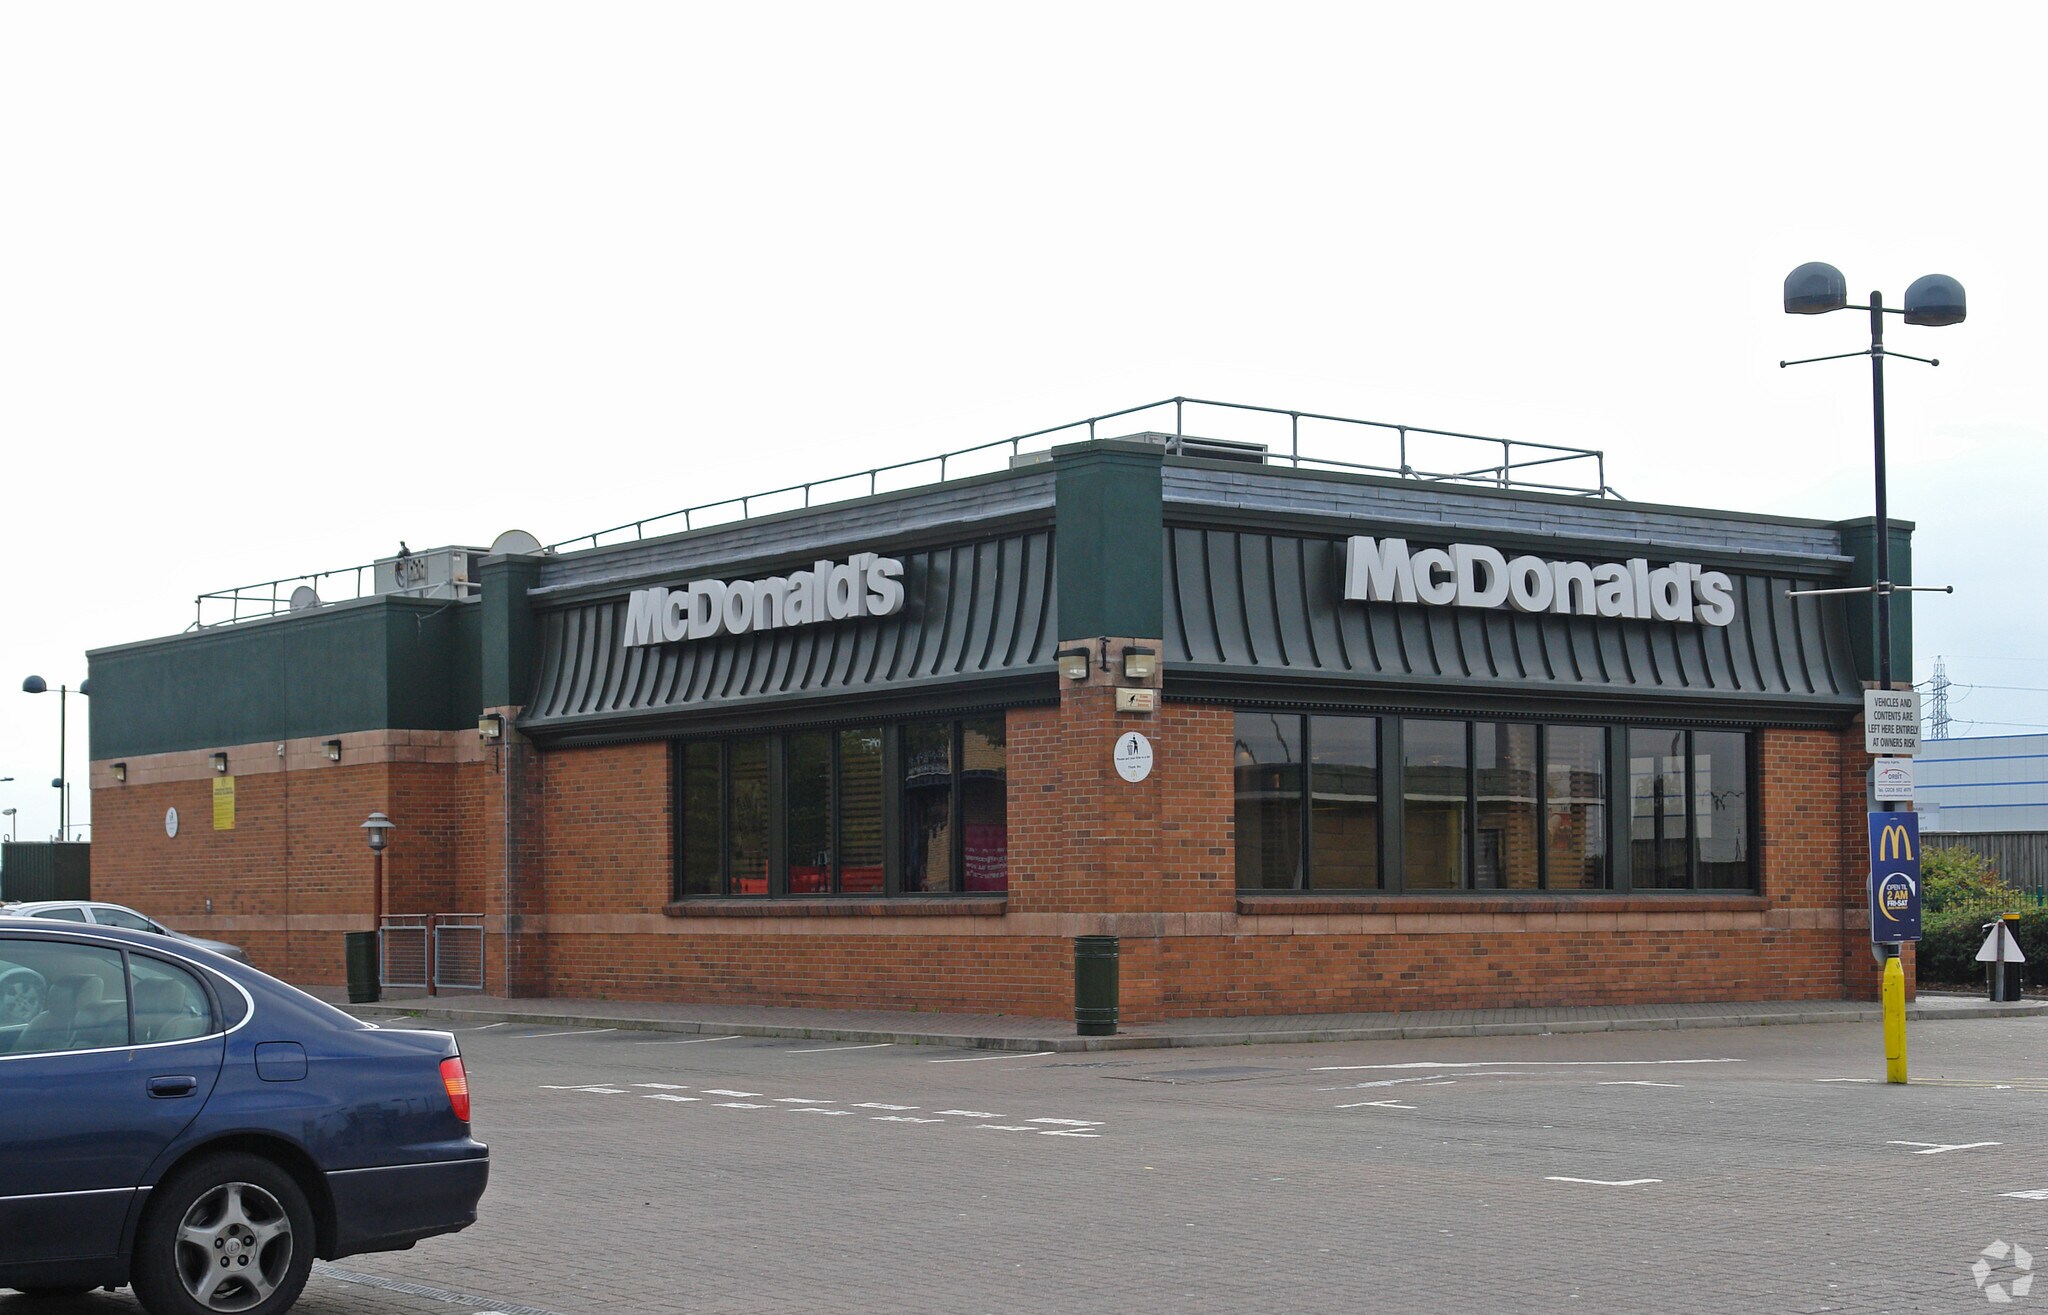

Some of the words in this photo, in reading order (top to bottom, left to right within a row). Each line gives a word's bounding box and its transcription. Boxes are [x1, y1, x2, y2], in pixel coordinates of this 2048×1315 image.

[1344, 535, 1735, 627] McDonald's
[624, 552, 904, 647] McDonald's
[1874, 698, 1898, 708] VEHICLES
[1900, 699, 1912, 708] AND
[1874, 711, 1900, 720] CONTENTS
[1902, 712, 1913, 720] ARE
[1868, 724, 1880, 734] LEFT
[1882, 725, 1894, 734] HERE
[1896, 725, 1919, 734] ENTIRELY
[1873, 738, 1879, 746] AT
[1880, 738, 1902, 747] OWNERS
[1904, 739, 1916, 748] RISK
[1887, 890, 1893, 900] 2
[1894, 890, 1908, 899] AM
